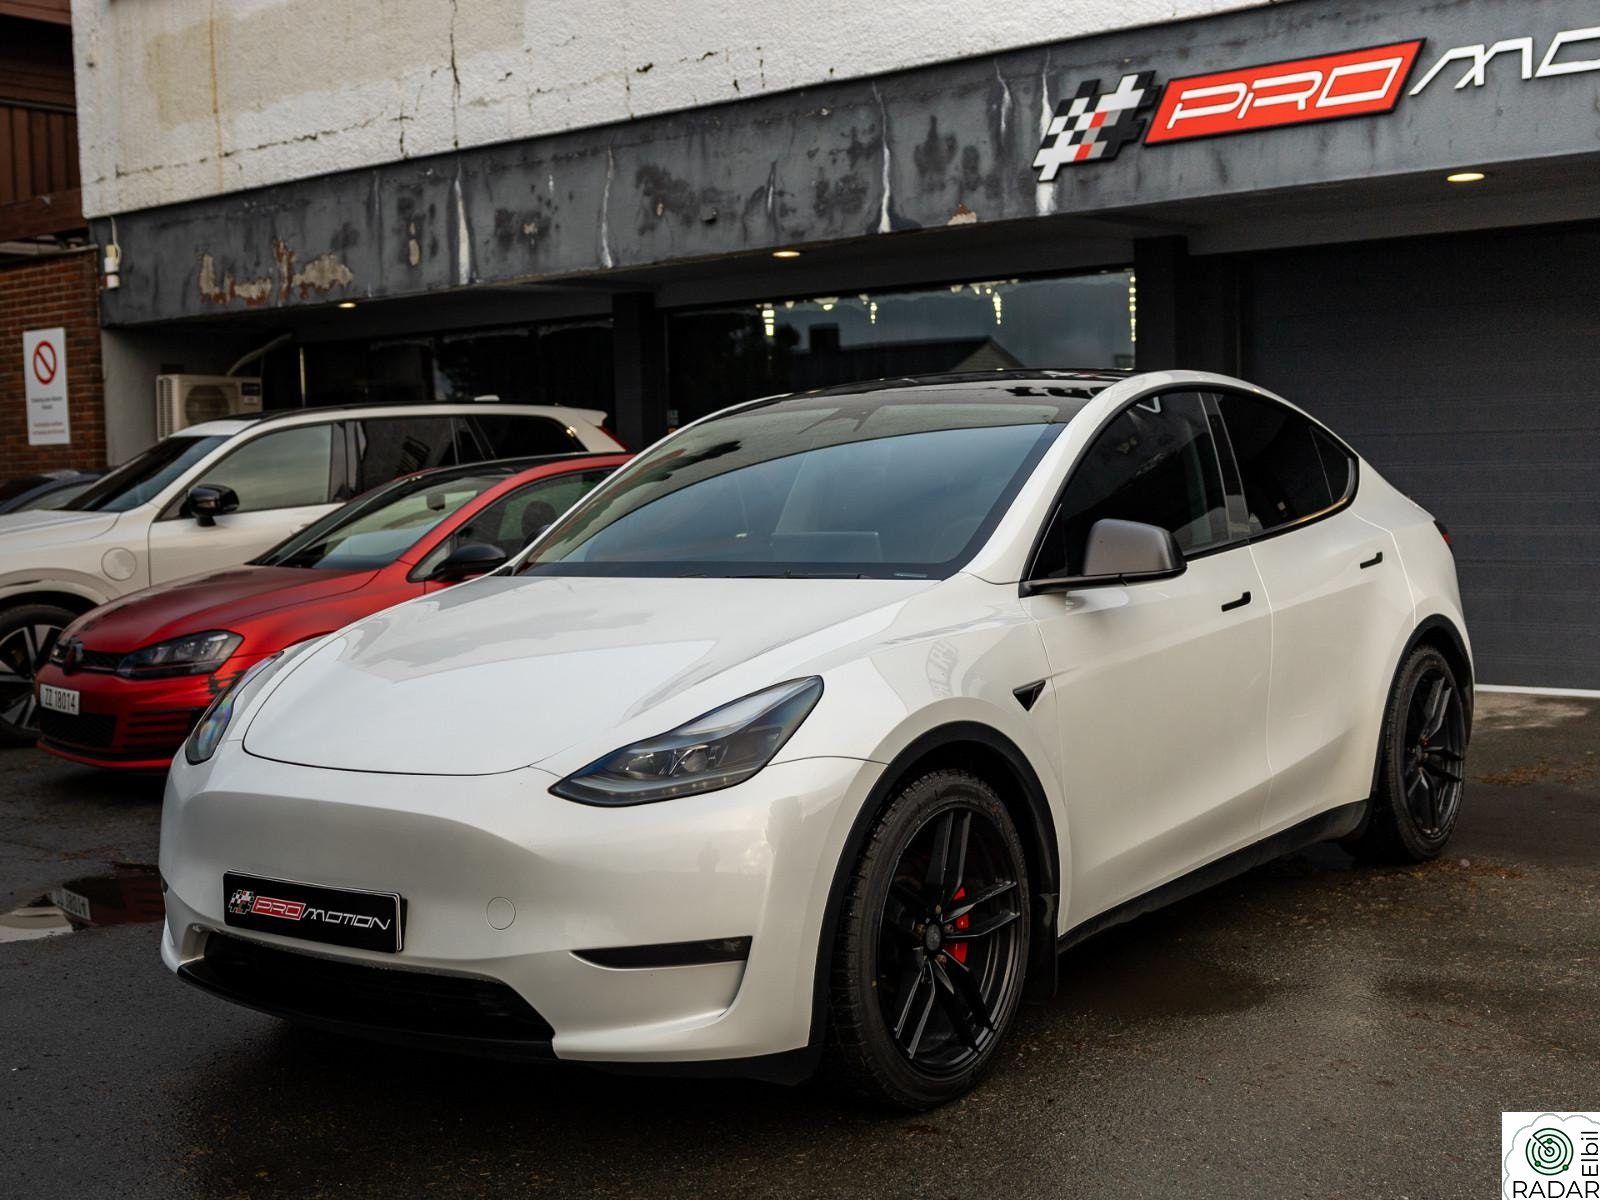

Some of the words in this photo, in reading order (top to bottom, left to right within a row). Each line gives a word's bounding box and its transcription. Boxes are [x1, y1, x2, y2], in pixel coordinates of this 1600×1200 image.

[1166, 57, 1403, 129] PRO
[45, 687, 52, 706] ZZ
[55, 690, 75, 710] 18014
[255, 900, 301, 917] PRO
[303, 907, 391, 930] MOTION
